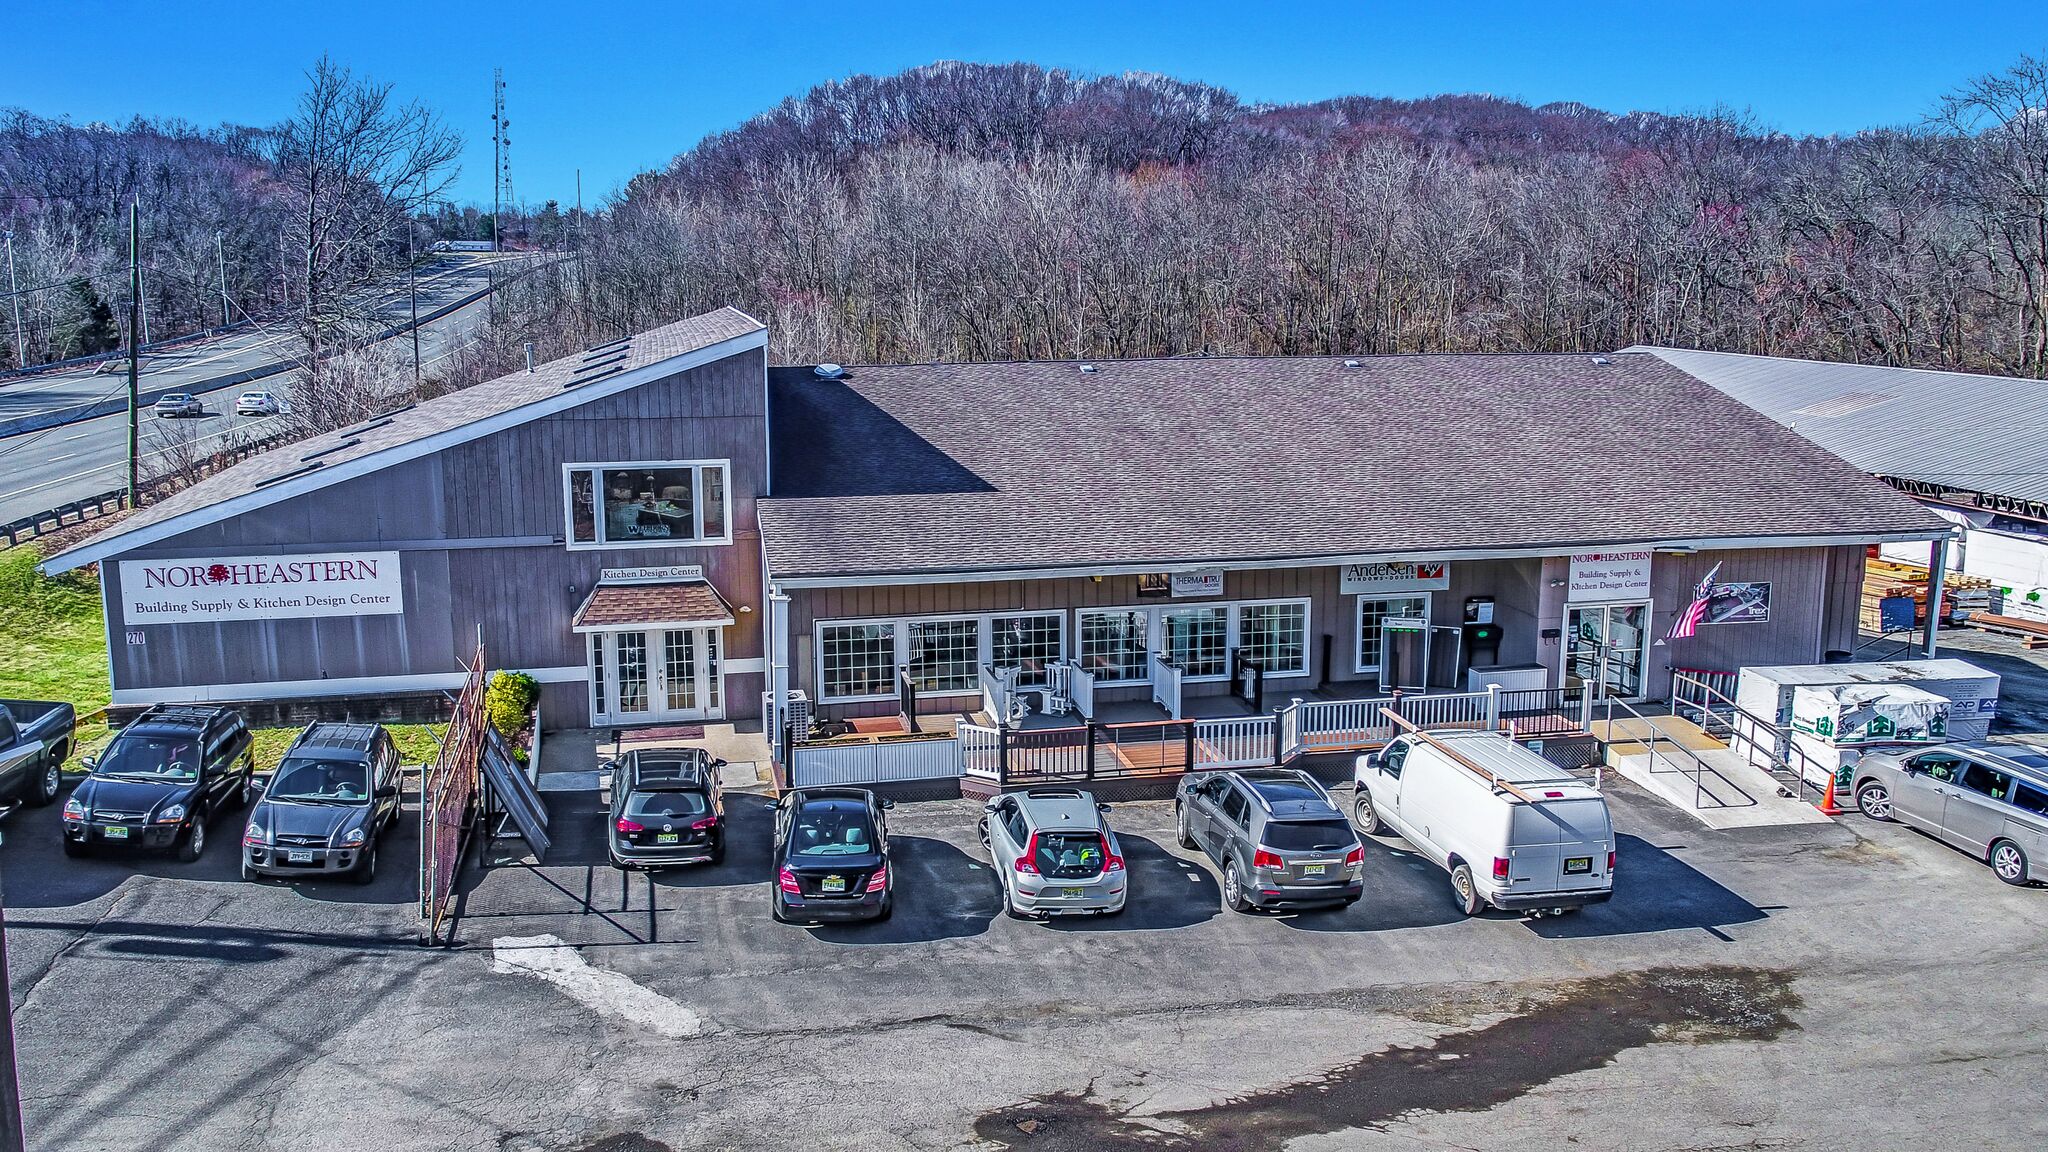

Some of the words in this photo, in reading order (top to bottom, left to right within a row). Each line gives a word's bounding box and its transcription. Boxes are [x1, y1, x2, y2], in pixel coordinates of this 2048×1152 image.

[604, 569, 637, 579] Kitchen
[639, 568, 668, 578] Design
[670, 567, 699, 576] Center
[1348, 562, 1414, 577] Andersen
[1579, 570, 1607, 579] Building
[1609, 569, 1632, 579] Supply
[1634, 568, 1641, 576] &
[1571, 582, 1597, 591] Kitchen
[1599, 581, 1623, 590] Design
[1624, 580, 1648, 588] Center
[135, 601, 188, 614] Building
[191, 599, 233, 612] Supply
[237, 598, 250, 609] &
[253, 596, 301, 609] Kitchen
[305, 595, 346, 607] Design
[350, 593, 391, 605] Center
[1748, 606, 1767, 615] Trex
[127, 632, 144, 644] 270
